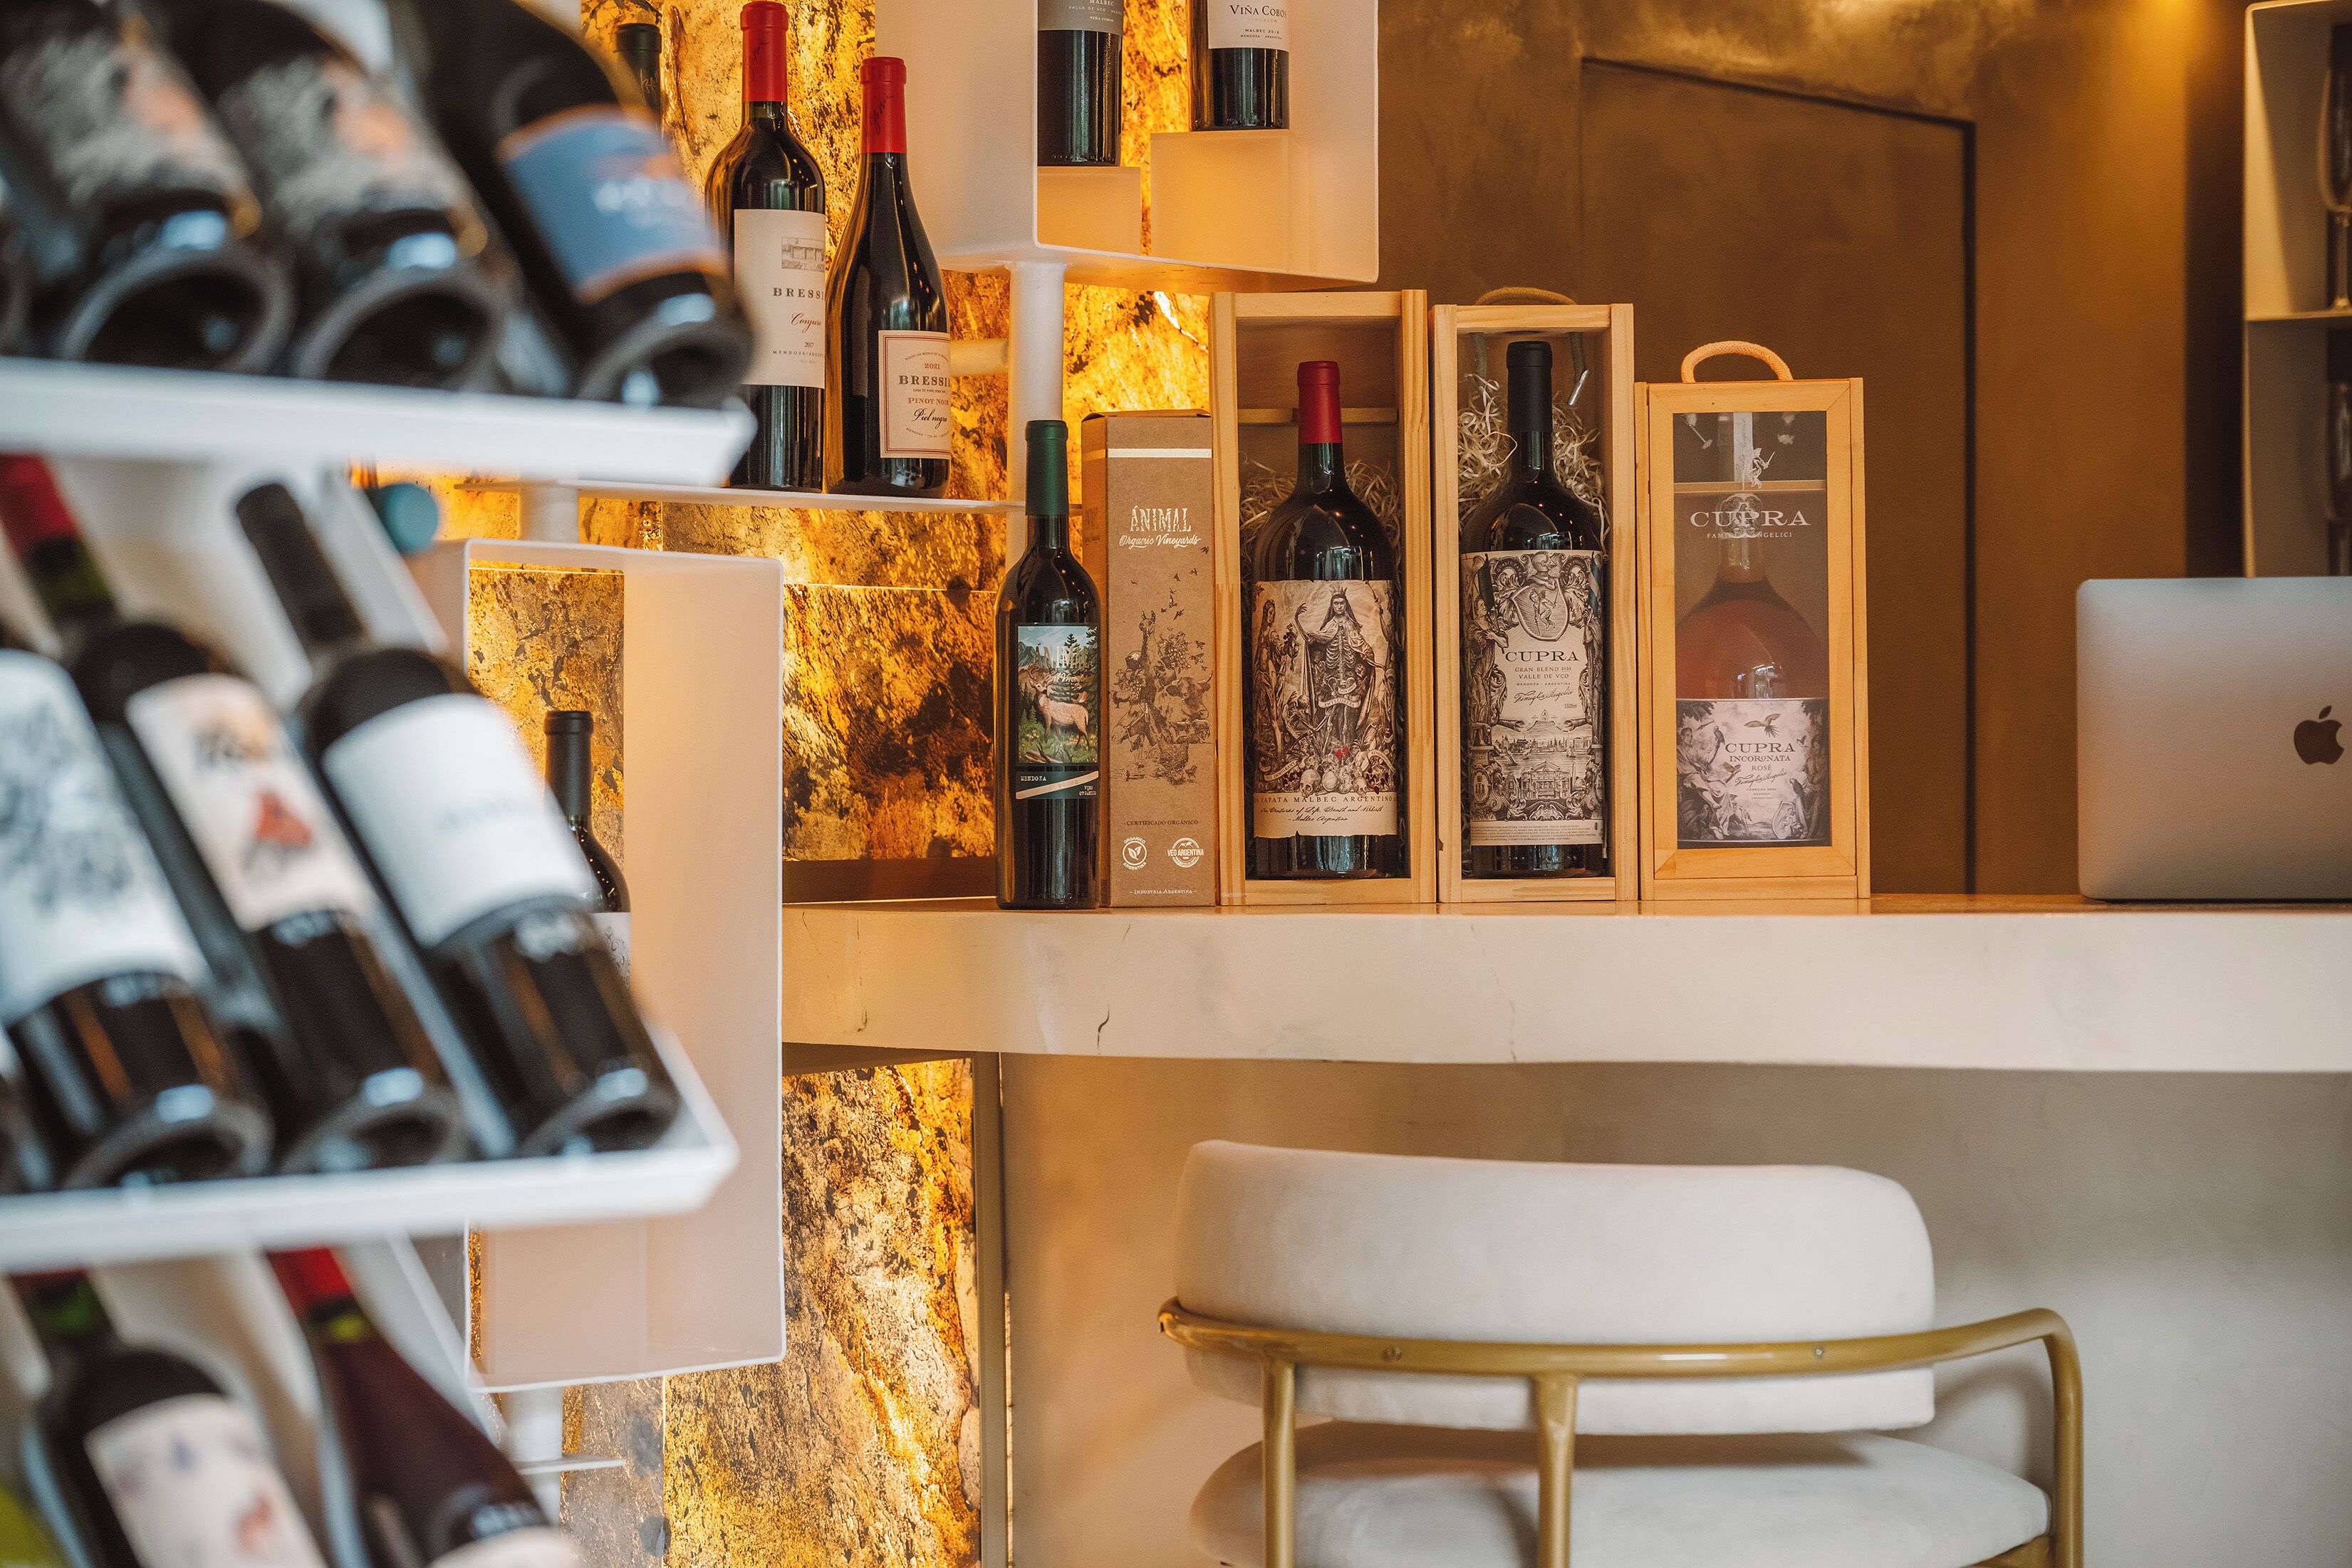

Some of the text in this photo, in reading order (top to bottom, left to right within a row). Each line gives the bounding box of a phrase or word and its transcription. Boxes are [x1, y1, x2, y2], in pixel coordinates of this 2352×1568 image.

[1229, 5, 1287, 19] VIÑA COBOS
[912, 408, 935, 422] Piel
[1130, 505, 1192, 532] ÁNIMAL
[1690, 511, 1811, 528] CUPRA
[1119, 533, 1202, 550] Organic Vineyards
[1505, 651, 1579, 662] CUPRA
[1725, 743, 1796, 753] CUPRA
[1123, 862, 1147, 870] ARGENTINA
